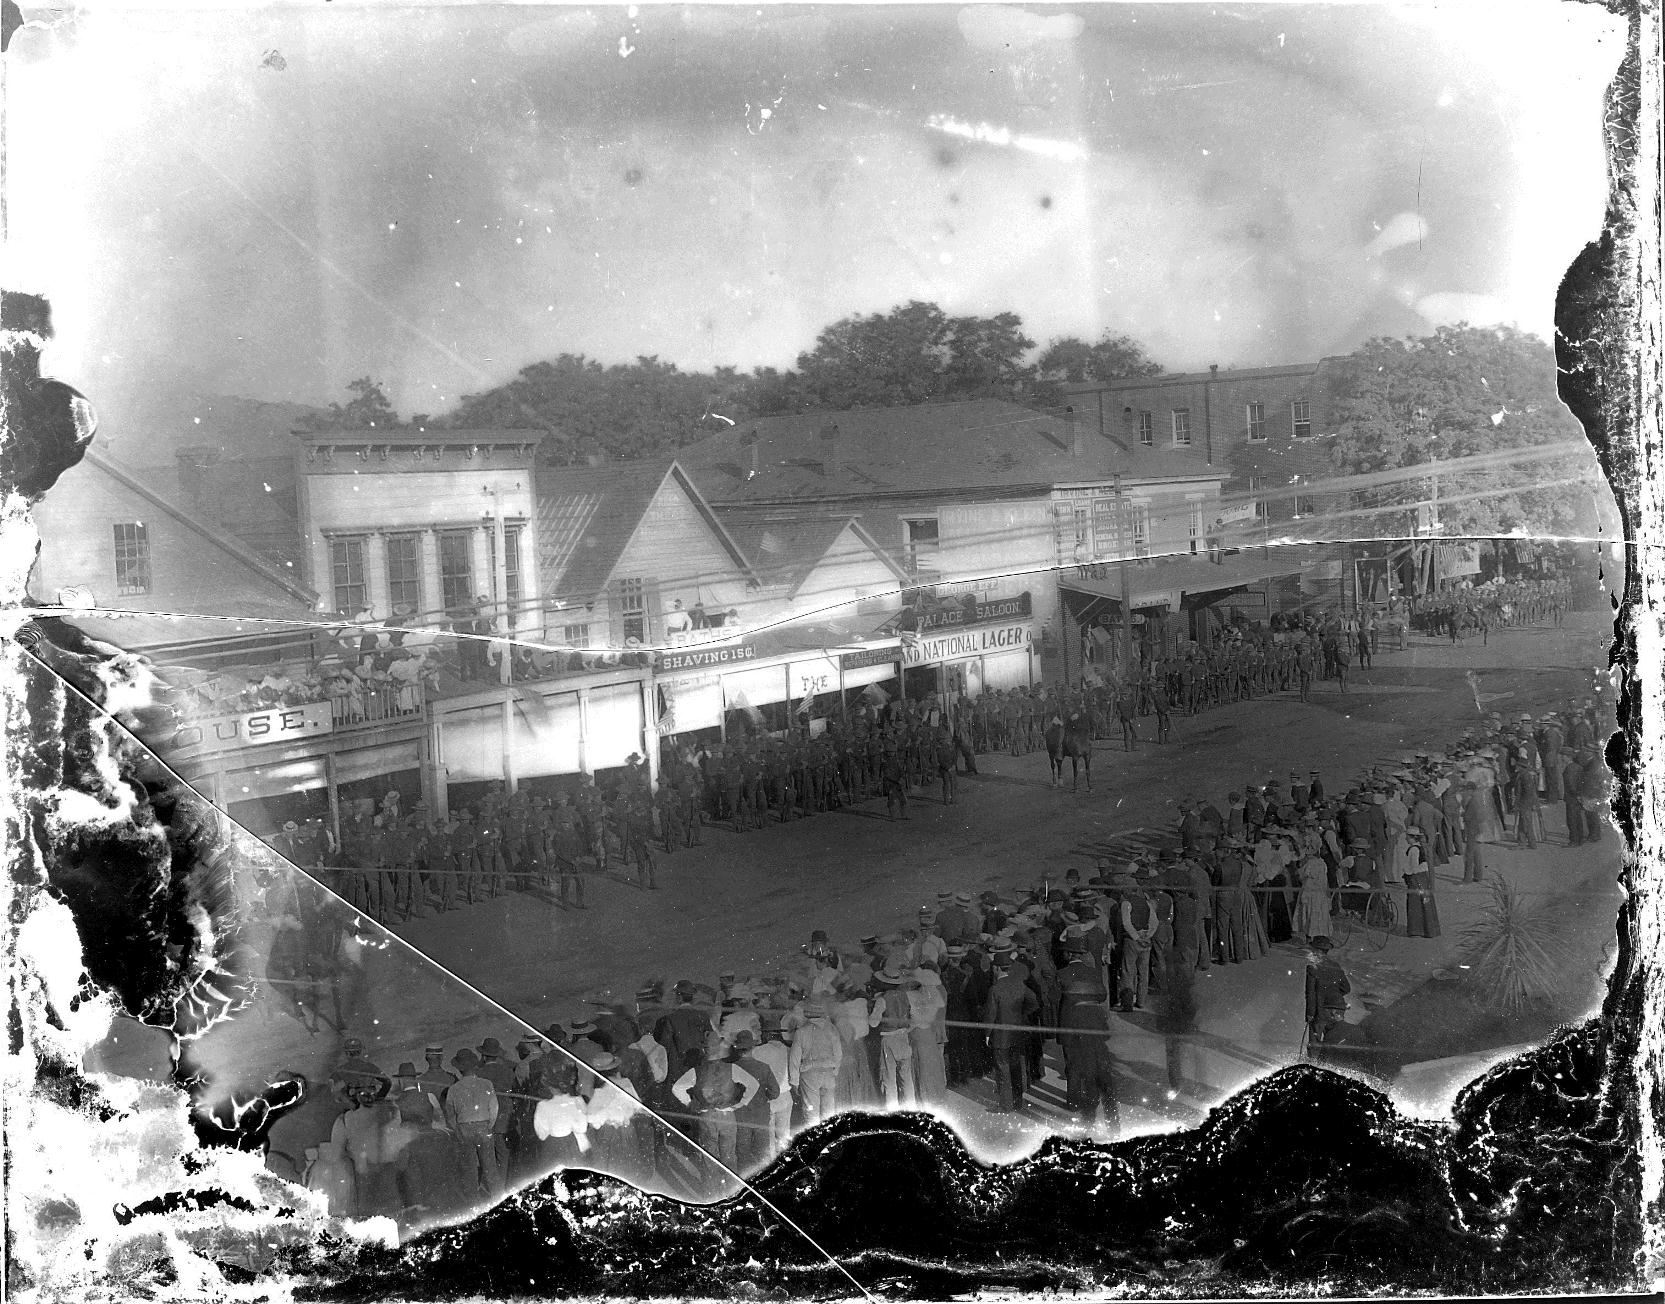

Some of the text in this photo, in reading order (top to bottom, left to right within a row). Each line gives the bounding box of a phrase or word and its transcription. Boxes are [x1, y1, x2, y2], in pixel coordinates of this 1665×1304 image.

[917, 601, 1020, 628] PALACE SALOON
[923, 634, 978, 660] NATIONAL
[982, 626, 1023, 650] LAGER
[663, 650, 729, 669] SHAVING
